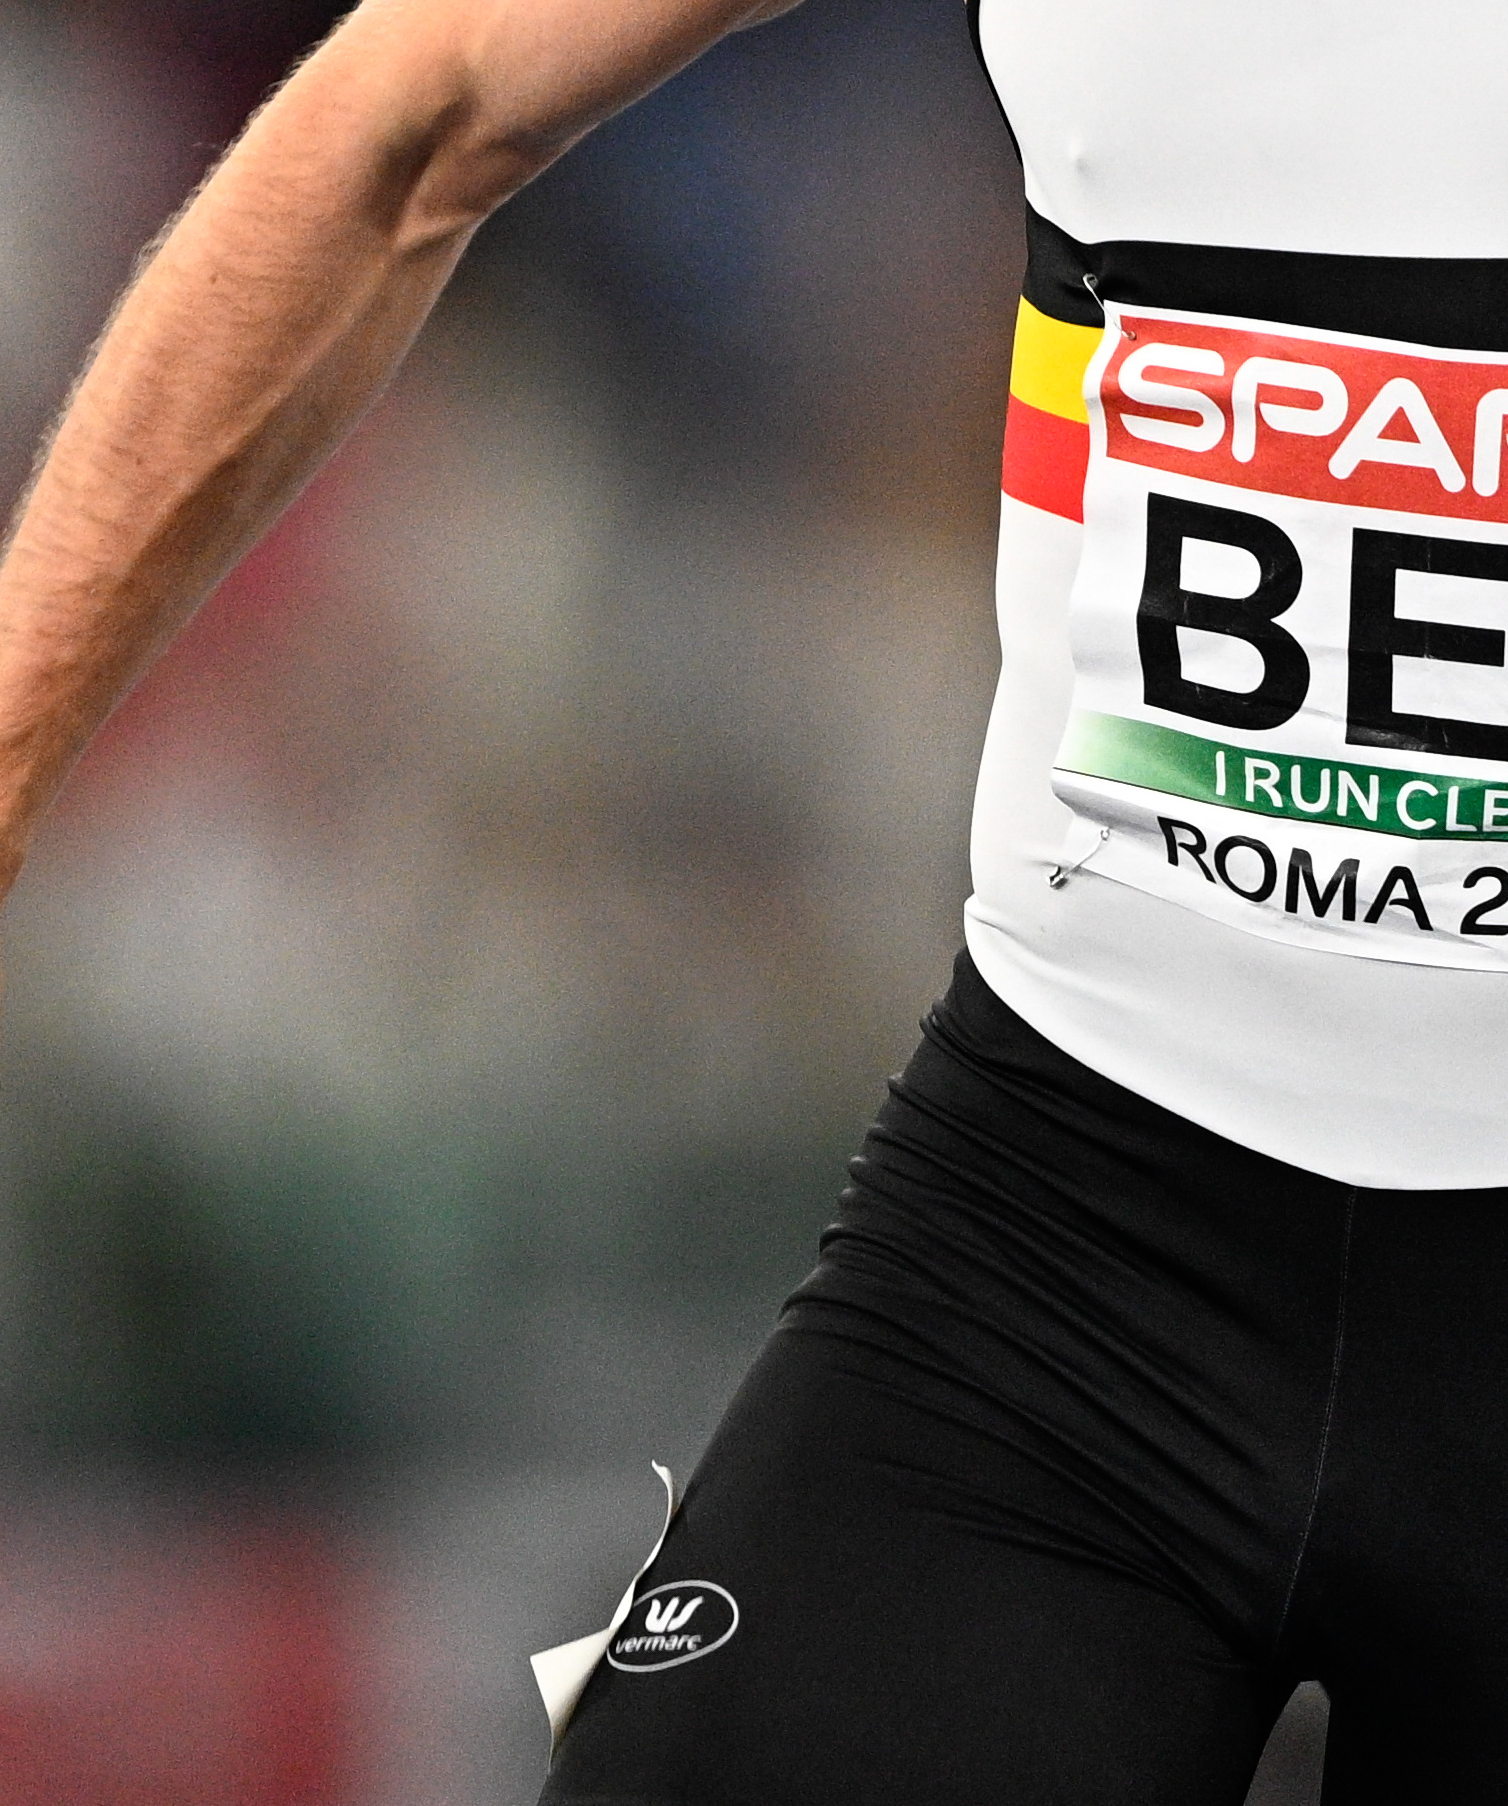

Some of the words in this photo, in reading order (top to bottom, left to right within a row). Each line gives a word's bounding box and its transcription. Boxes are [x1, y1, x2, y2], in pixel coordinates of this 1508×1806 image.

[1214, 750, 1227, 796] I
[1243, 755, 1380, 822] RUN
[1156, 814, 1435, 933] ROMA
[615, 1634, 703, 1655] vermarc
